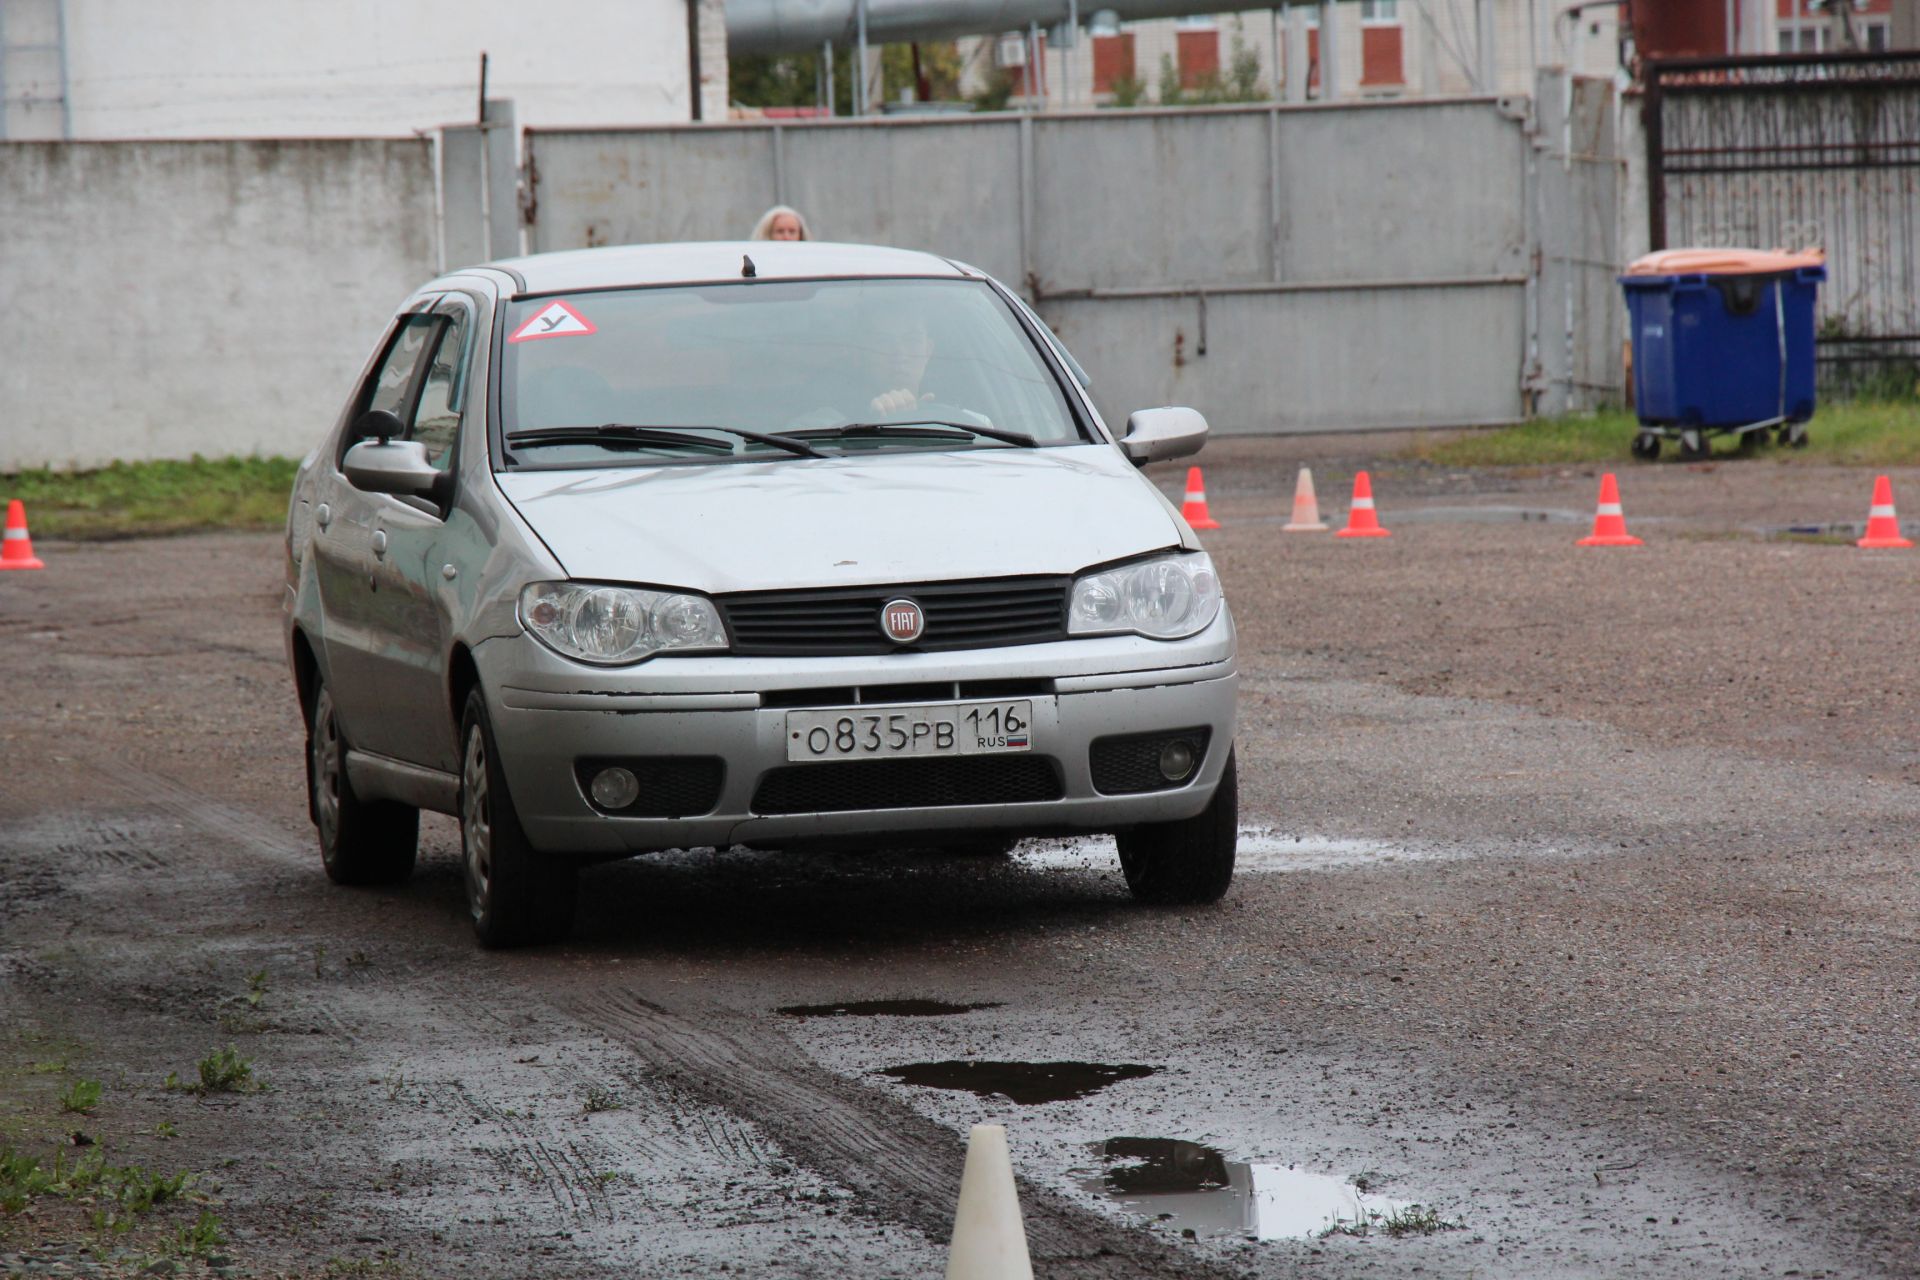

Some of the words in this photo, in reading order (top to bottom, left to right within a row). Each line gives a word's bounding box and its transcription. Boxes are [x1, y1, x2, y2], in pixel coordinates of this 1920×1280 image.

[890, 612, 915, 631] FIAT
[966, 706, 1020, 735] 116
[977, 736, 1006, 748] RUS
